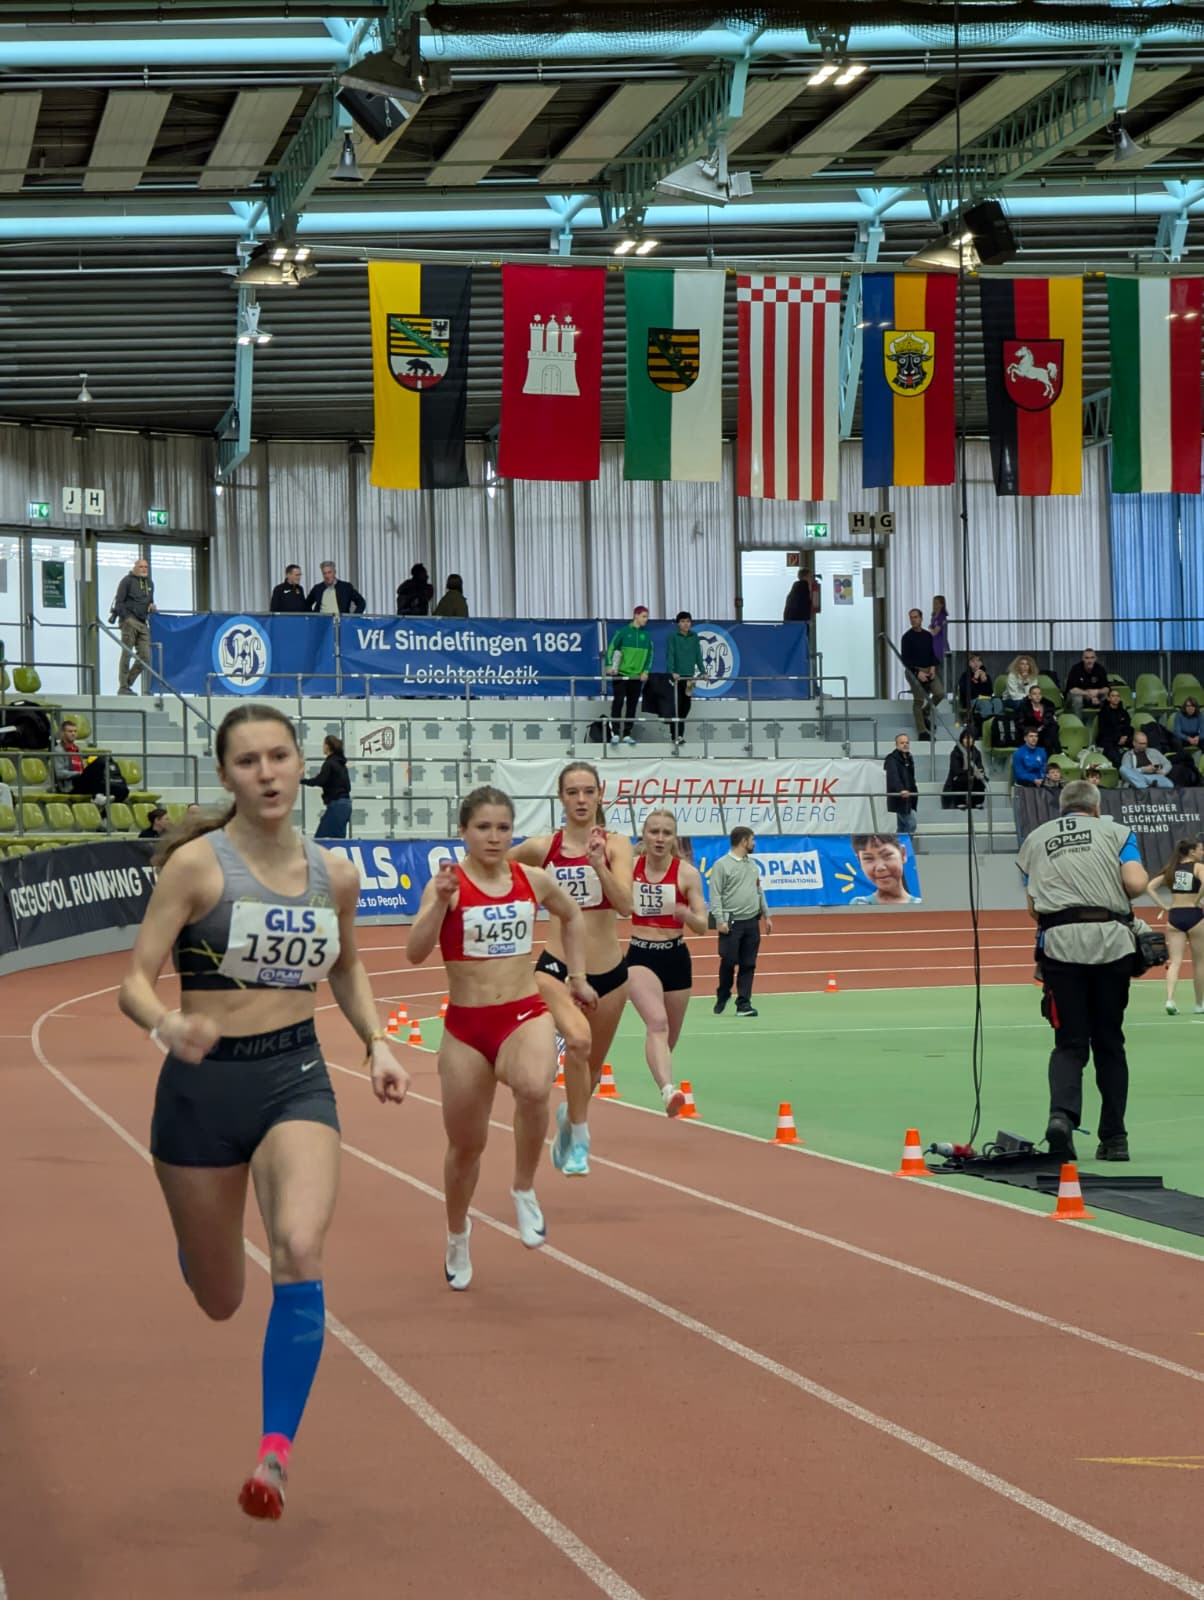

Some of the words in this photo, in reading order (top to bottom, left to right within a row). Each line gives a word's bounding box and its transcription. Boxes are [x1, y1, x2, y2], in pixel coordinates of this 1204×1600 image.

[68, 490, 75, 505] J
[89, 492, 100, 507] H
[853, 514, 865, 527] H
[880, 514, 892, 528] G
[357, 628, 391, 650] VfL
[395, 629, 527, 656] Sindelfingen
[532, 632, 582, 653] 1862
[403, 663, 539, 685] Leichtathletik
[601, 778, 840, 806] LEICHTATHLETIK
[1121, 803, 1178, 814] DEUTSCHER
[1056, 817, 1077, 833] 15
[1122, 813, 1201, 824] LEICHTATHLETIK
[1130, 824, 1169, 833] ERBAND
[1062, 832, 1090, 842] PLAN
[556, 867, 585, 881] GLS
[768, 859, 817, 875] PLAN
[558, 881, 590, 897] 21
[640, 884, 663, 895] GLS
[367, 896, 377, 907] to
[639, 894, 664, 908] 113
[483, 905, 517, 921] GLS
[474, 920, 527, 942] 1450
[241, 933, 328, 967] 1303
[649, 942, 674, 950] PRO
[232, 1031, 294, 1056] NIKE
